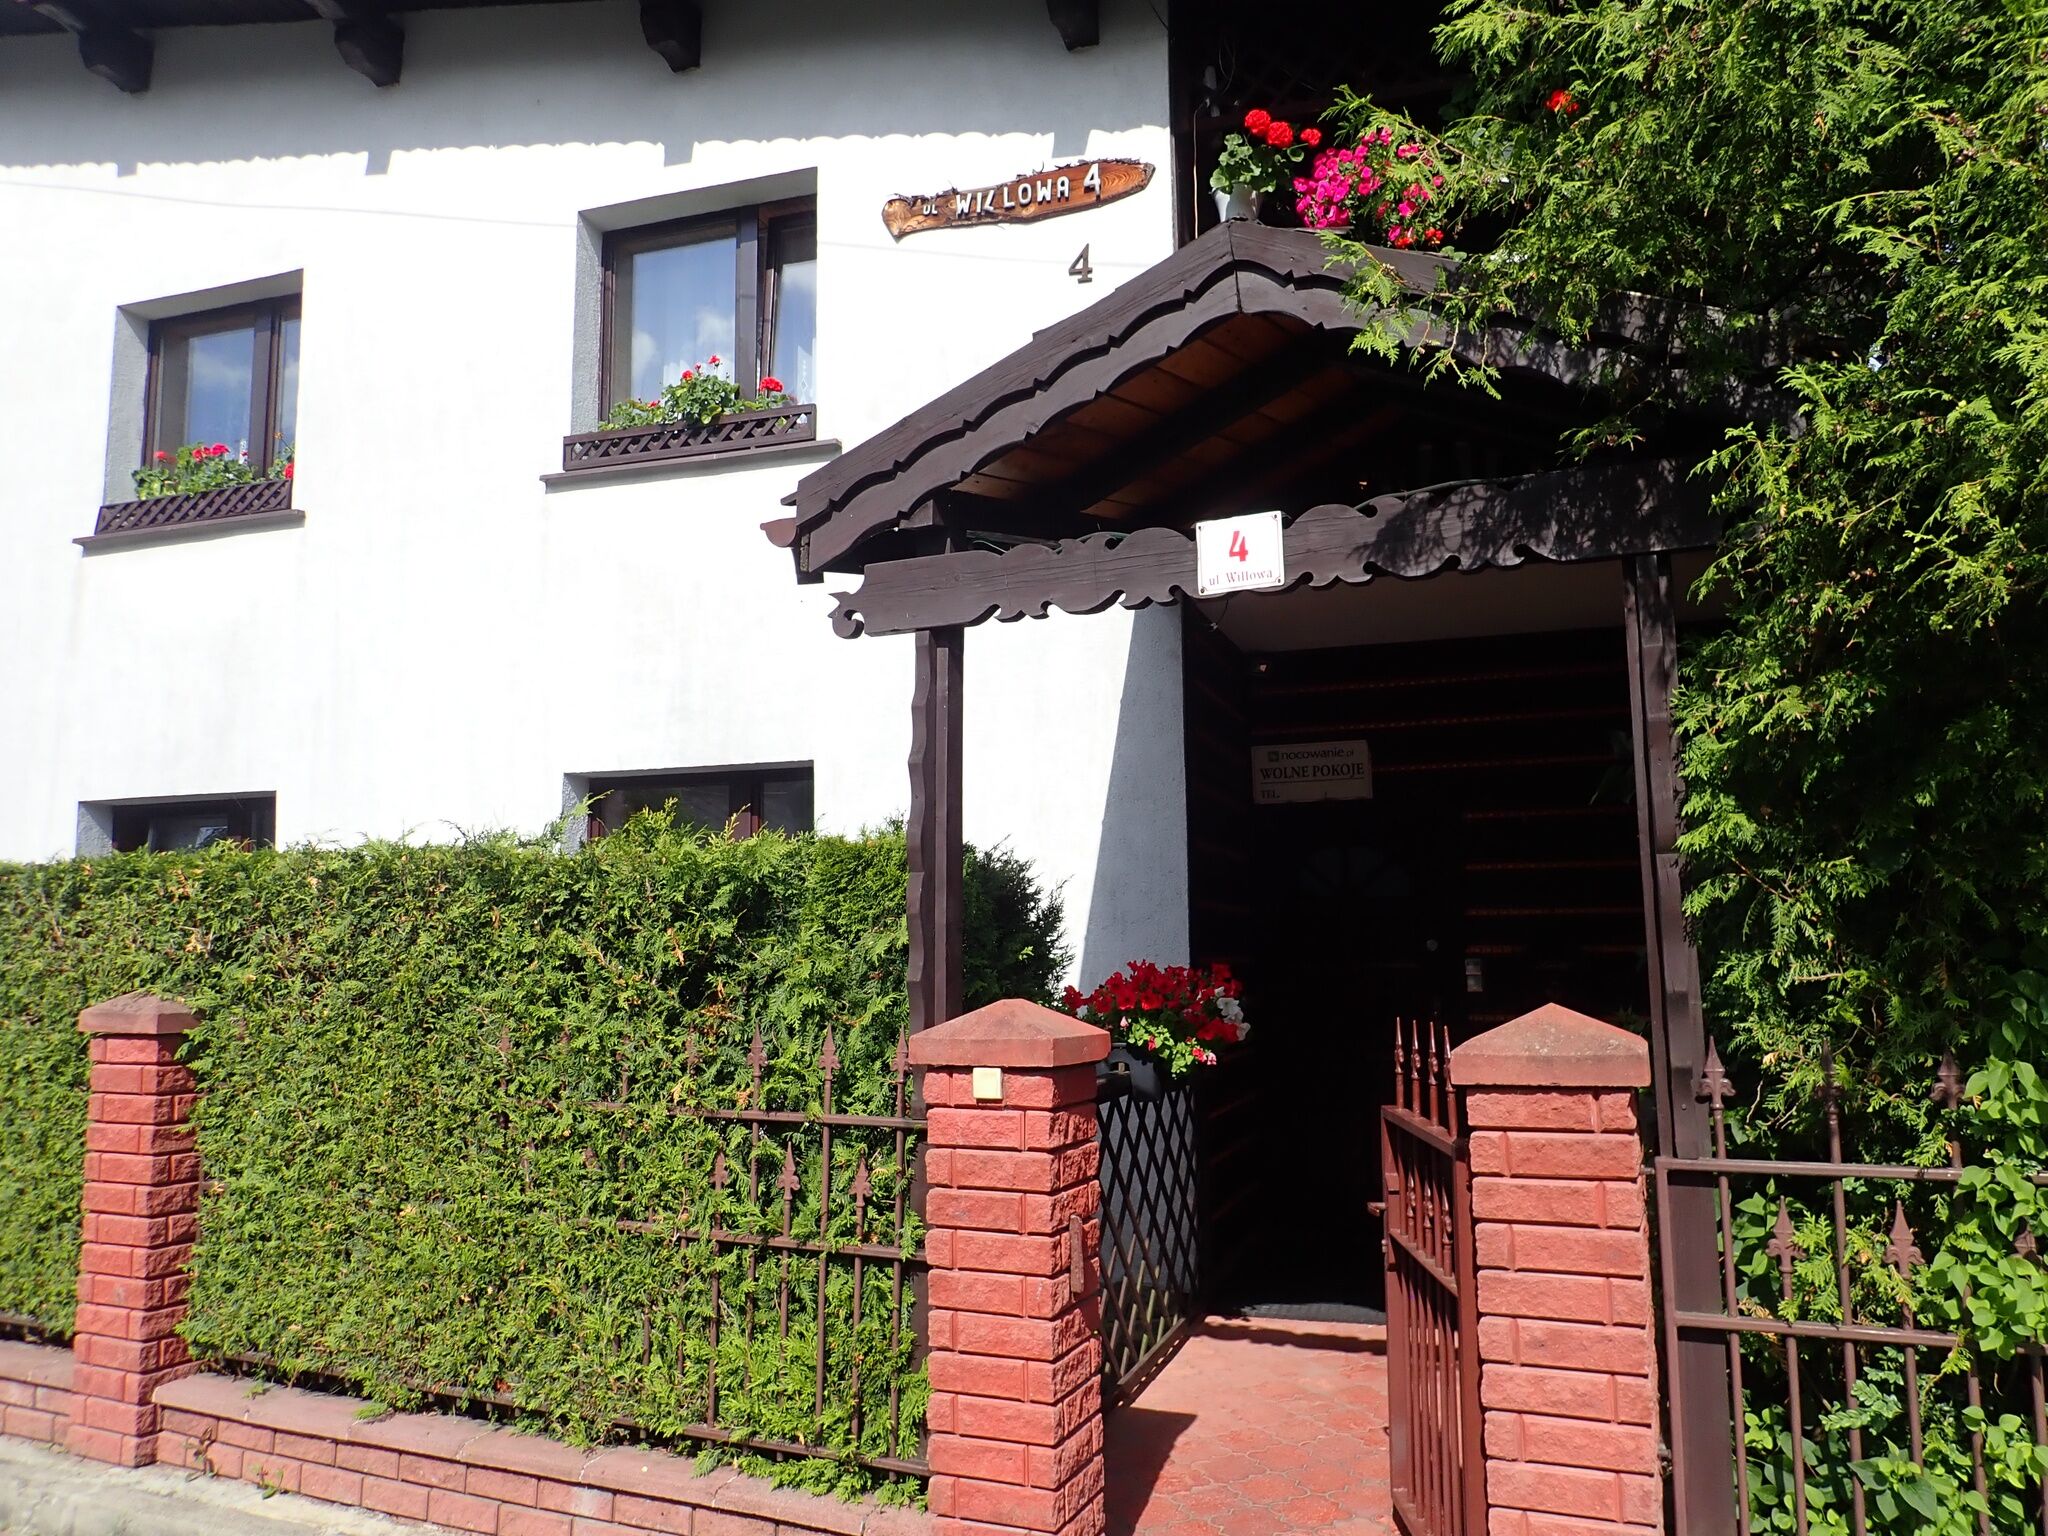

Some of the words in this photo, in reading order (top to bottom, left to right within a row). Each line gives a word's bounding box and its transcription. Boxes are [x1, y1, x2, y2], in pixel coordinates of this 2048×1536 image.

[955, 175, 1070, 216] WILLOWA
[1083, 163, 1101, 196] 4
[1068, 243, 1093, 284] 4
[1229, 530, 1249, 562] 4
[1226, 569, 1273, 584] Willowa
[1260, 765, 1310, 780] WOLNE
[1312, 762, 1365, 779] POKOJE
